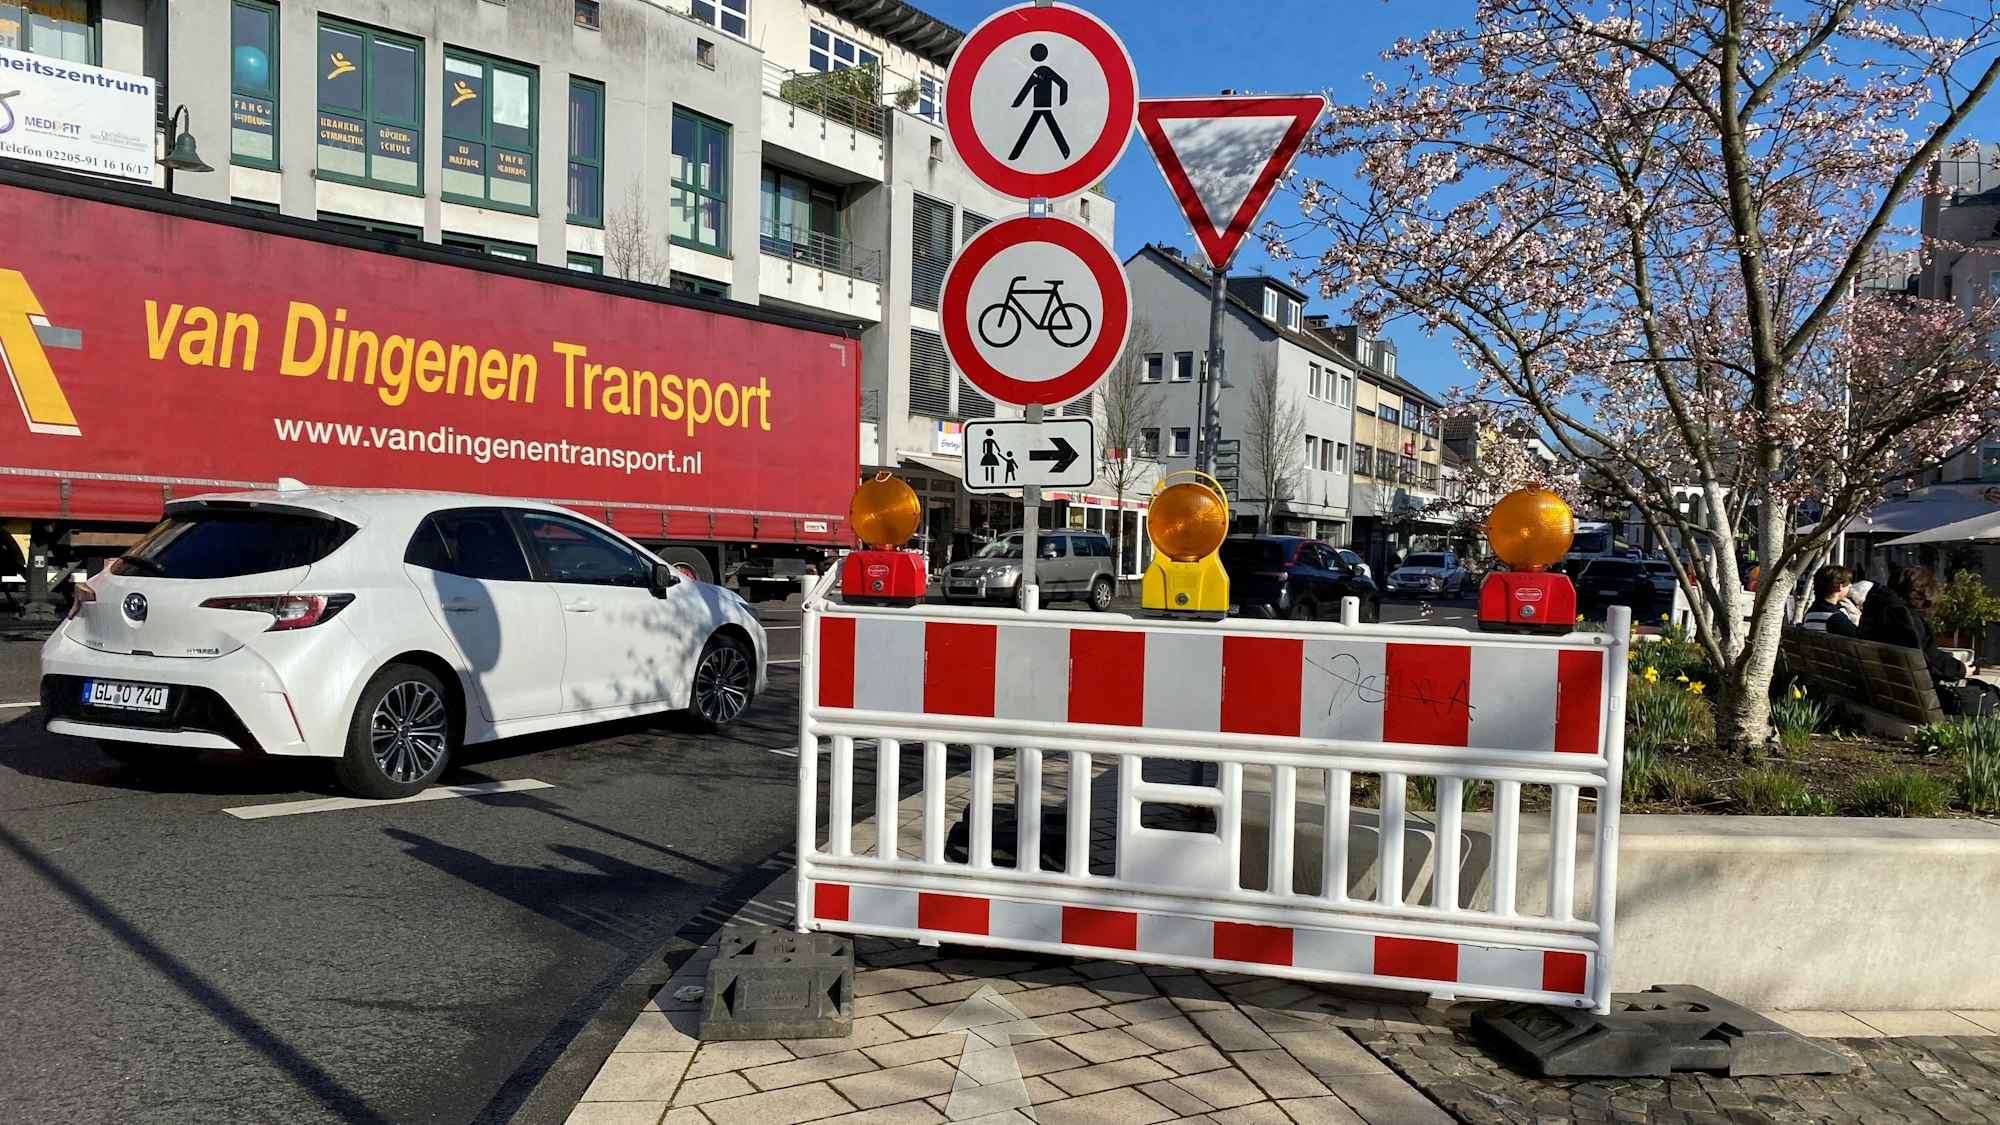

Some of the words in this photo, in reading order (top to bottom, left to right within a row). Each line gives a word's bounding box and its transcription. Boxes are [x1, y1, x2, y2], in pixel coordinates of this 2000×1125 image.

[320, 117, 363, 133] KRANKEN-
[320, 130, 364, 146] GYMNASTIK
[379, 128, 411, 142] RÜCKEN-
[380, 141, 411, 155] SCHULE
[0, 141, 42, 157] Telefon
[46, 149, 97, 167] 02205-91
[104, 159, 116, 170] 16
[120, 162, 149, 175] 16/17
[448, 155, 479, 168] MASSAGE
[145, 299, 258, 371] van
[280, 301, 538, 407] Dingenen
[553, 341, 771, 437] Transport
[274, 417, 702, 475] www.vandingenentransport.nl
[95, 683, 112, 700] GL
[136, 686, 163, 706] 740
